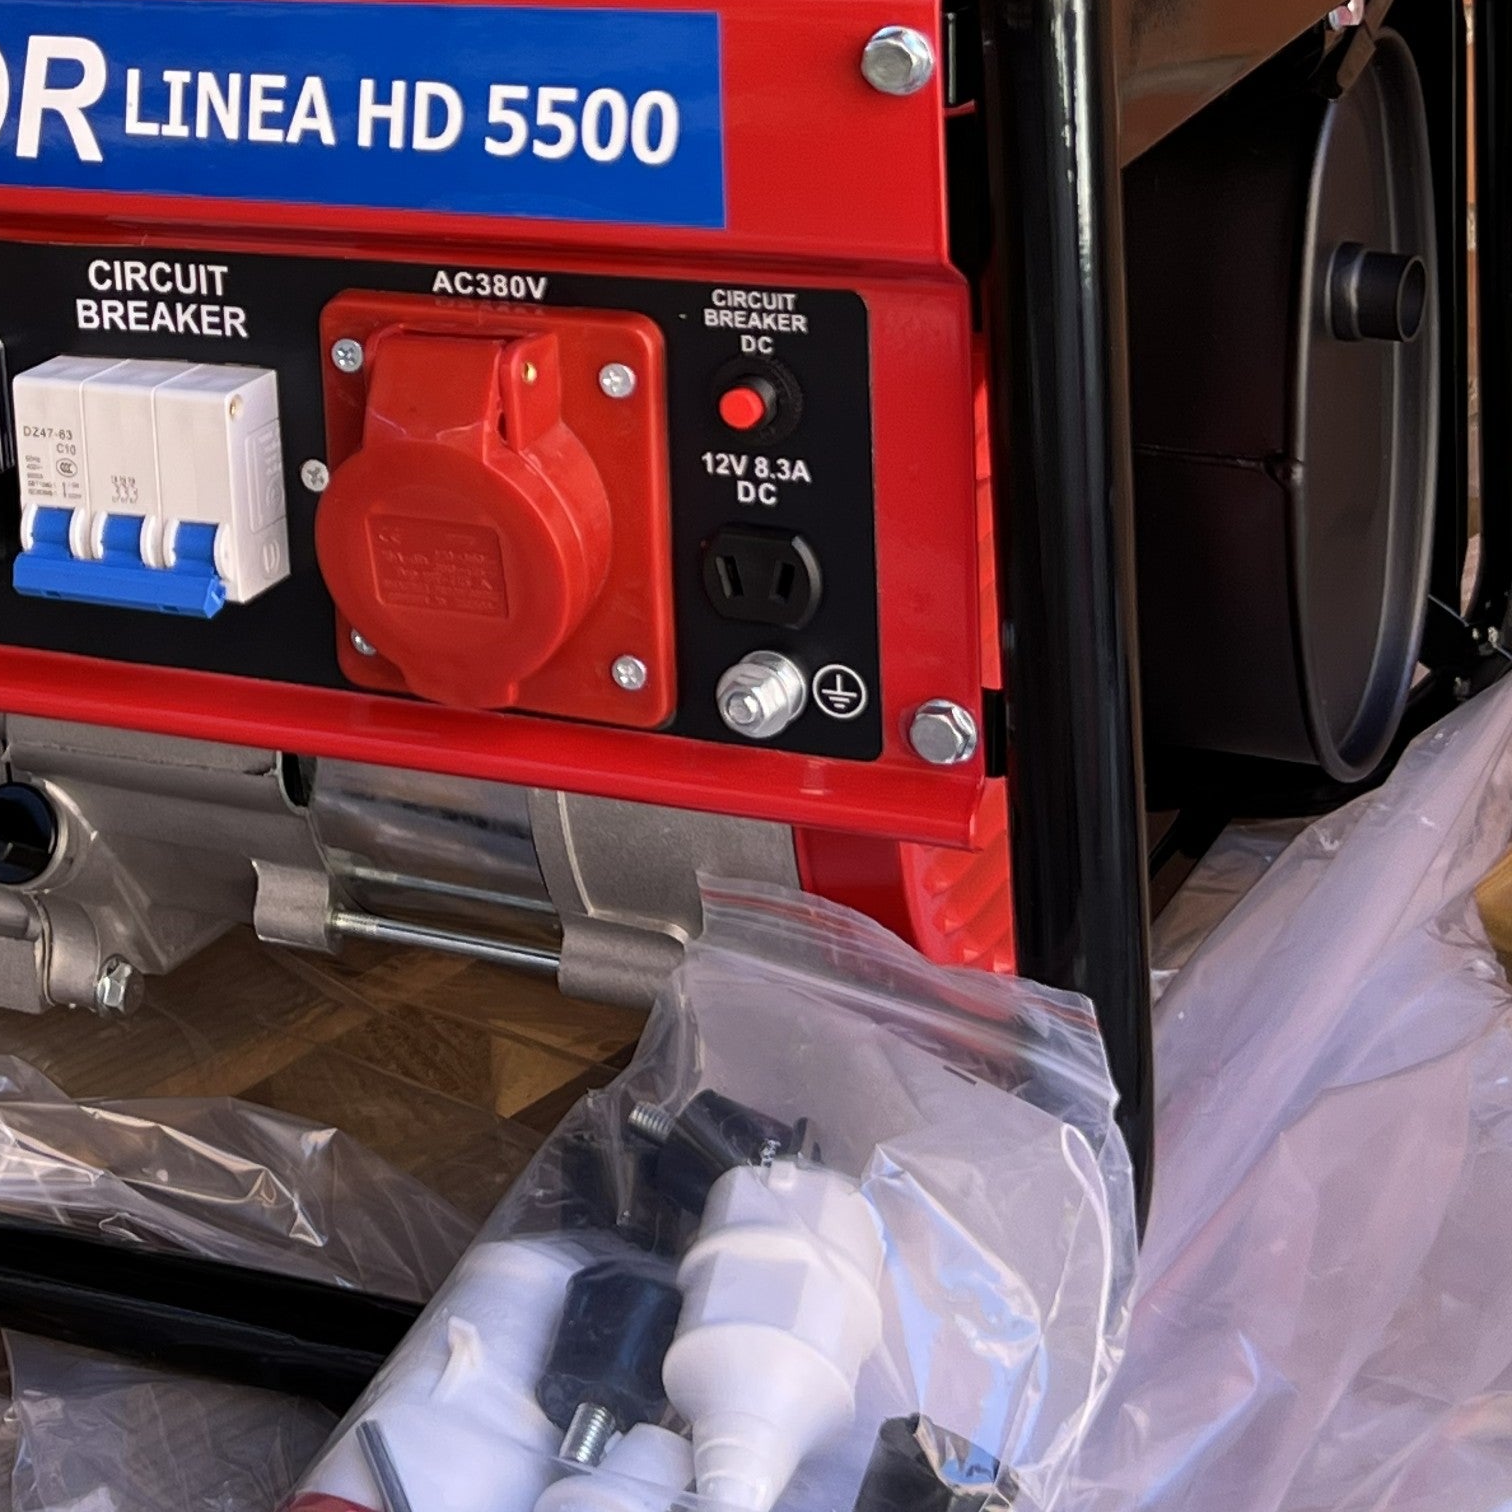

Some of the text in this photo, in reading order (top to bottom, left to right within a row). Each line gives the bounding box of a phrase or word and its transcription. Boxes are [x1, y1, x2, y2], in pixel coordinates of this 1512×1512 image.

[124, 68, 336, 148] LINEA
[357, 79, 464, 152] HD
[484, 87, 680, 166] 5500
[88, 259, 229, 296] CIRCUIT
[432, 270, 548, 300] AC380V
[711, 289, 798, 312] CIRCUIT
[75, 298, 249, 338] BREAKER
[703, 308, 808, 334] BREAKER
[740, 335, 774, 354] DC
[701, 451, 812, 483] 12V 8.3A
[737, 480, 777, 505] DC
